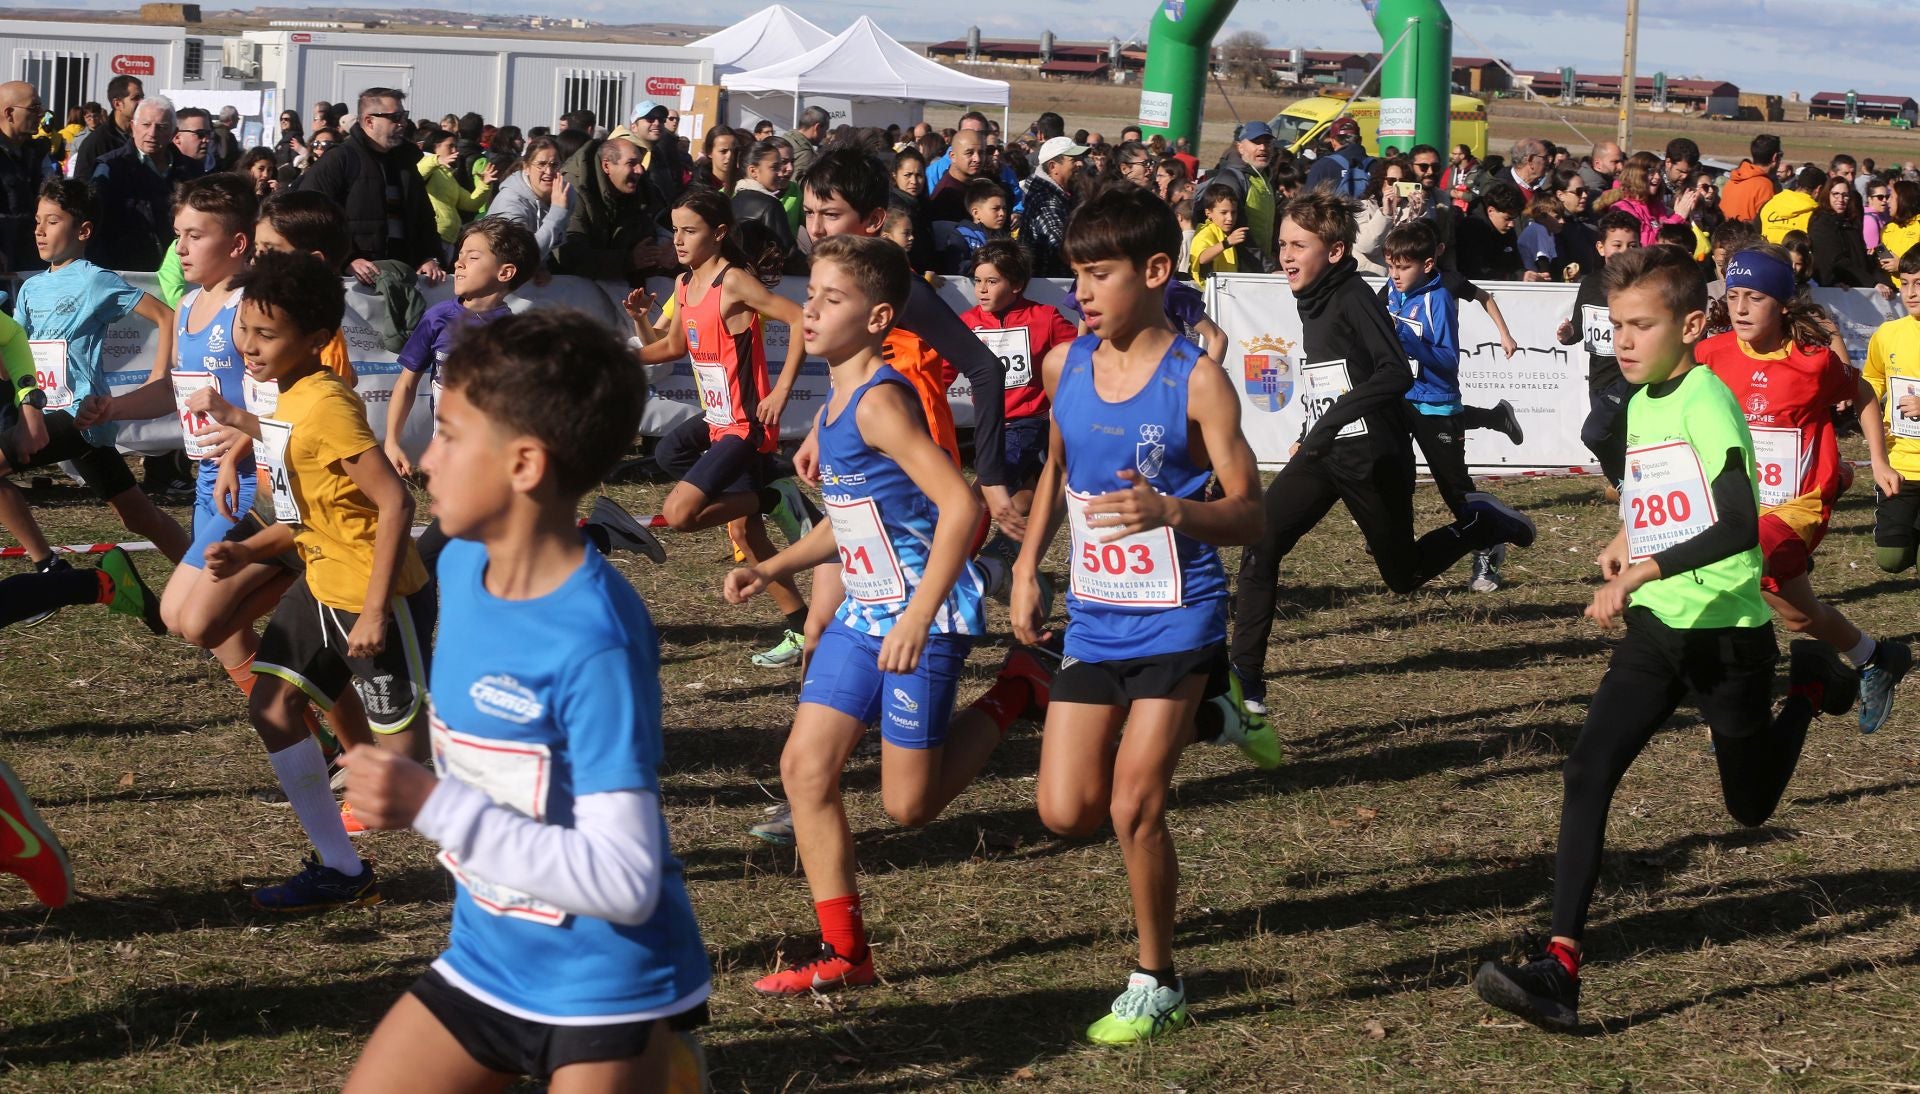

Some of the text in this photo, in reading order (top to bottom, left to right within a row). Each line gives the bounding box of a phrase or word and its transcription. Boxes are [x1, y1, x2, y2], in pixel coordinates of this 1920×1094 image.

[115, 57, 150, 70] Carma
[1587, 327, 1612, 343] 104
[1631, 490, 1691, 530] 280
[1658, 527, 1695, 541] NACIONAL
[1082, 541, 1155, 575] 503
[1113, 579, 1156, 589] NACIONAL
[1158, 580, 1169, 588] DE
[1082, 585, 1167, 599] CANTIMPALOS 2025
